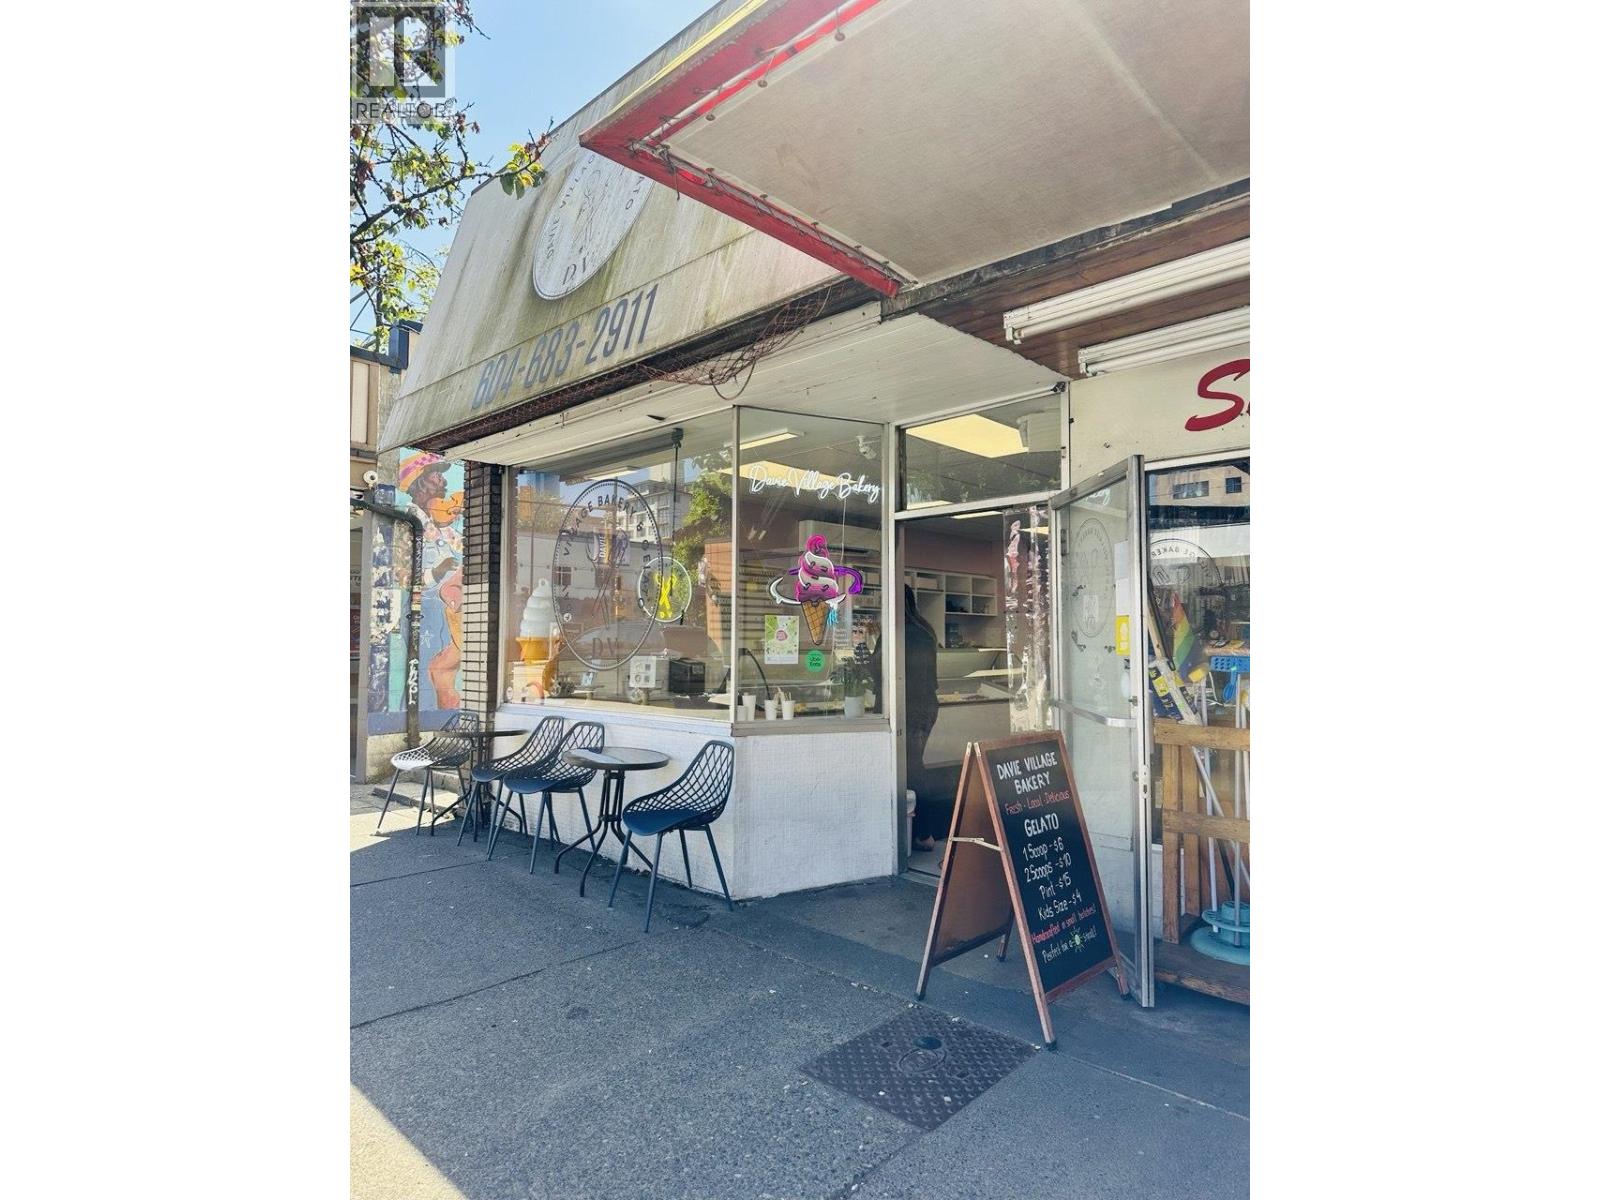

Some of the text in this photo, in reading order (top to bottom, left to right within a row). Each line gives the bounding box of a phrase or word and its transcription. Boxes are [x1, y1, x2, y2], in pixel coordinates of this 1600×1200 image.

[471, 284, 659, 411] 604-683-2911
[1185, 359, 1250, 431] S
[749, 465, 880, 503] Davie Village Bakery
[997, 752, 1058, 780] DAVIE VILLAGE
[1014, 771, 1050, 795] BAKERY
[1024, 812, 1059, 837] GELATO
[1039, 880, 1056, 900] Pint
[1038, 904, 1055, 921] Kids
[1053, 899, 1068, 914] Size
